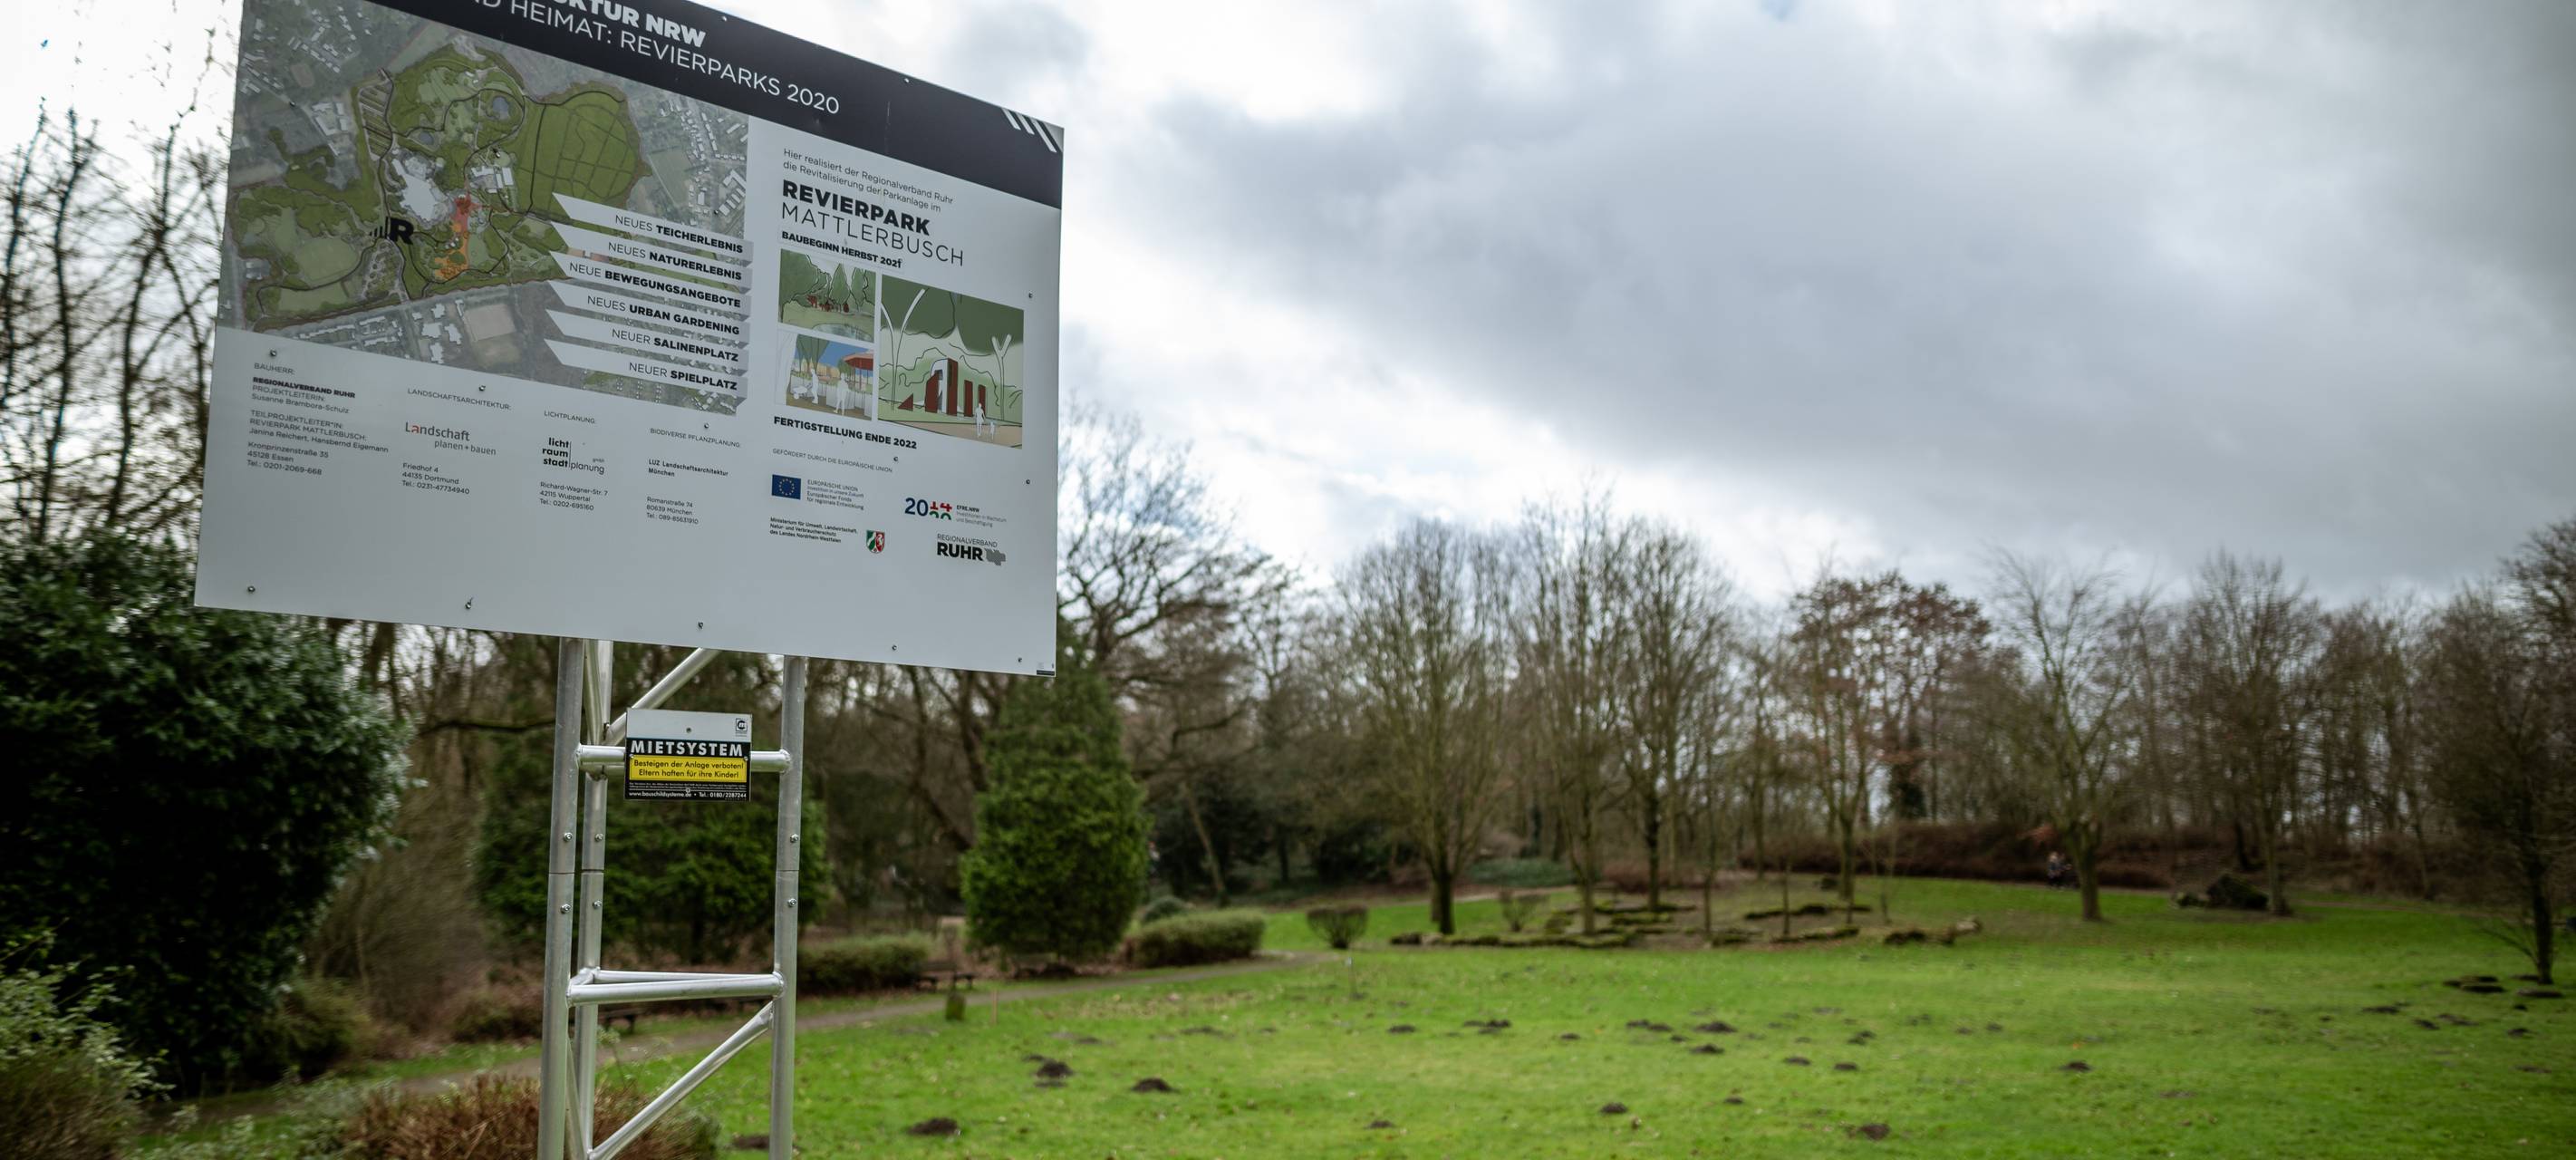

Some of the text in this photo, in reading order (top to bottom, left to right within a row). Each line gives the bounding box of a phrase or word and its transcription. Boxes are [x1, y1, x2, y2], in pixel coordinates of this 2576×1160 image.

[646, 14, 707, 47] NRW
[511, 0, 840, 115] HEIMAT: REVIERPARKS 2020
[783, 161, 941, 212] die Revitalisierung der Parkanlage im
[784, 149, 953, 205] Hier realisiert der Regionalverband Ruhr
[783, 179, 931, 237] REVIERPARK
[615, 215, 743, 254] NEUES TEICHERLEBNIS
[782, 201, 963, 266] MATTLERBUSCH
[782, 231, 840, 253] BAUBEGINN
[841, 246, 878, 263] HERBST
[608, 241, 742, 281] NEUES NATURERLEBNIS
[569, 262, 741, 308] NEUE BEWEGUNGSANGEBOTE
[587, 295, 740, 335] NEUES URBAN GARDENING
[612, 328, 738, 362] NEUER SALINENPLATZ
[629, 362, 738, 391] NEUER SPIELPLATZ
[253, 376, 355, 399] REGIONALVERBAND RUHR
[251, 392, 349, 413] Susanne Brambora-Schulz
[250, 418, 367, 441] REVIERPARK MATTLERBUSCH:
[405, 421, 470, 441] Landschaft
[650, 428, 687, 440] BIODIVERSE
[774, 416, 917, 450] FERTIGSTELLUNG ENDE 2022
[247, 441, 317, 457] Kronprinzenstraße
[249, 428, 389, 453] Janina Reichert, Hansbernd Eigemann
[434, 440, 463, 450] planen
[470, 444, 497, 455] bauen
[548, 437, 569, 449] licht
[247, 450, 294, 462] 45128 Essen
[542, 448, 568, 458] raum
[772, 448, 806, 459] GEFÖRDERT
[807, 453, 827, 461] DURCH
[837, 459, 874, 470] EUROPÄISCHE
[263, 461, 323, 476] 0201-2069-668
[402, 462, 432, 472] Friedhof
[648, 468, 675, 477] München
[662, 460, 728, 476] Landschaftsarchitektur
[401, 471, 459, 485] 44135 Dortmund
[416, 482, 470, 495] 0231-47734940
[540, 481, 603, 496] Richard-Wagner-Str.
[558, 492, 591, 502] Wuppertal
[646, 496, 685, 507] Romanstraße
[667, 507, 693, 516] München
[770, 517, 797, 526] Ministerium
[937, 533, 998, 548] REGIONALVERBAND
[937, 542, 984, 562] RUHR
[631, 740, 743, 757] MIETSYSTEM
[633, 759, 669, 768] Besteigen
[671, 760, 682, 768] der
[685, 761, 709, 769] Anlage
